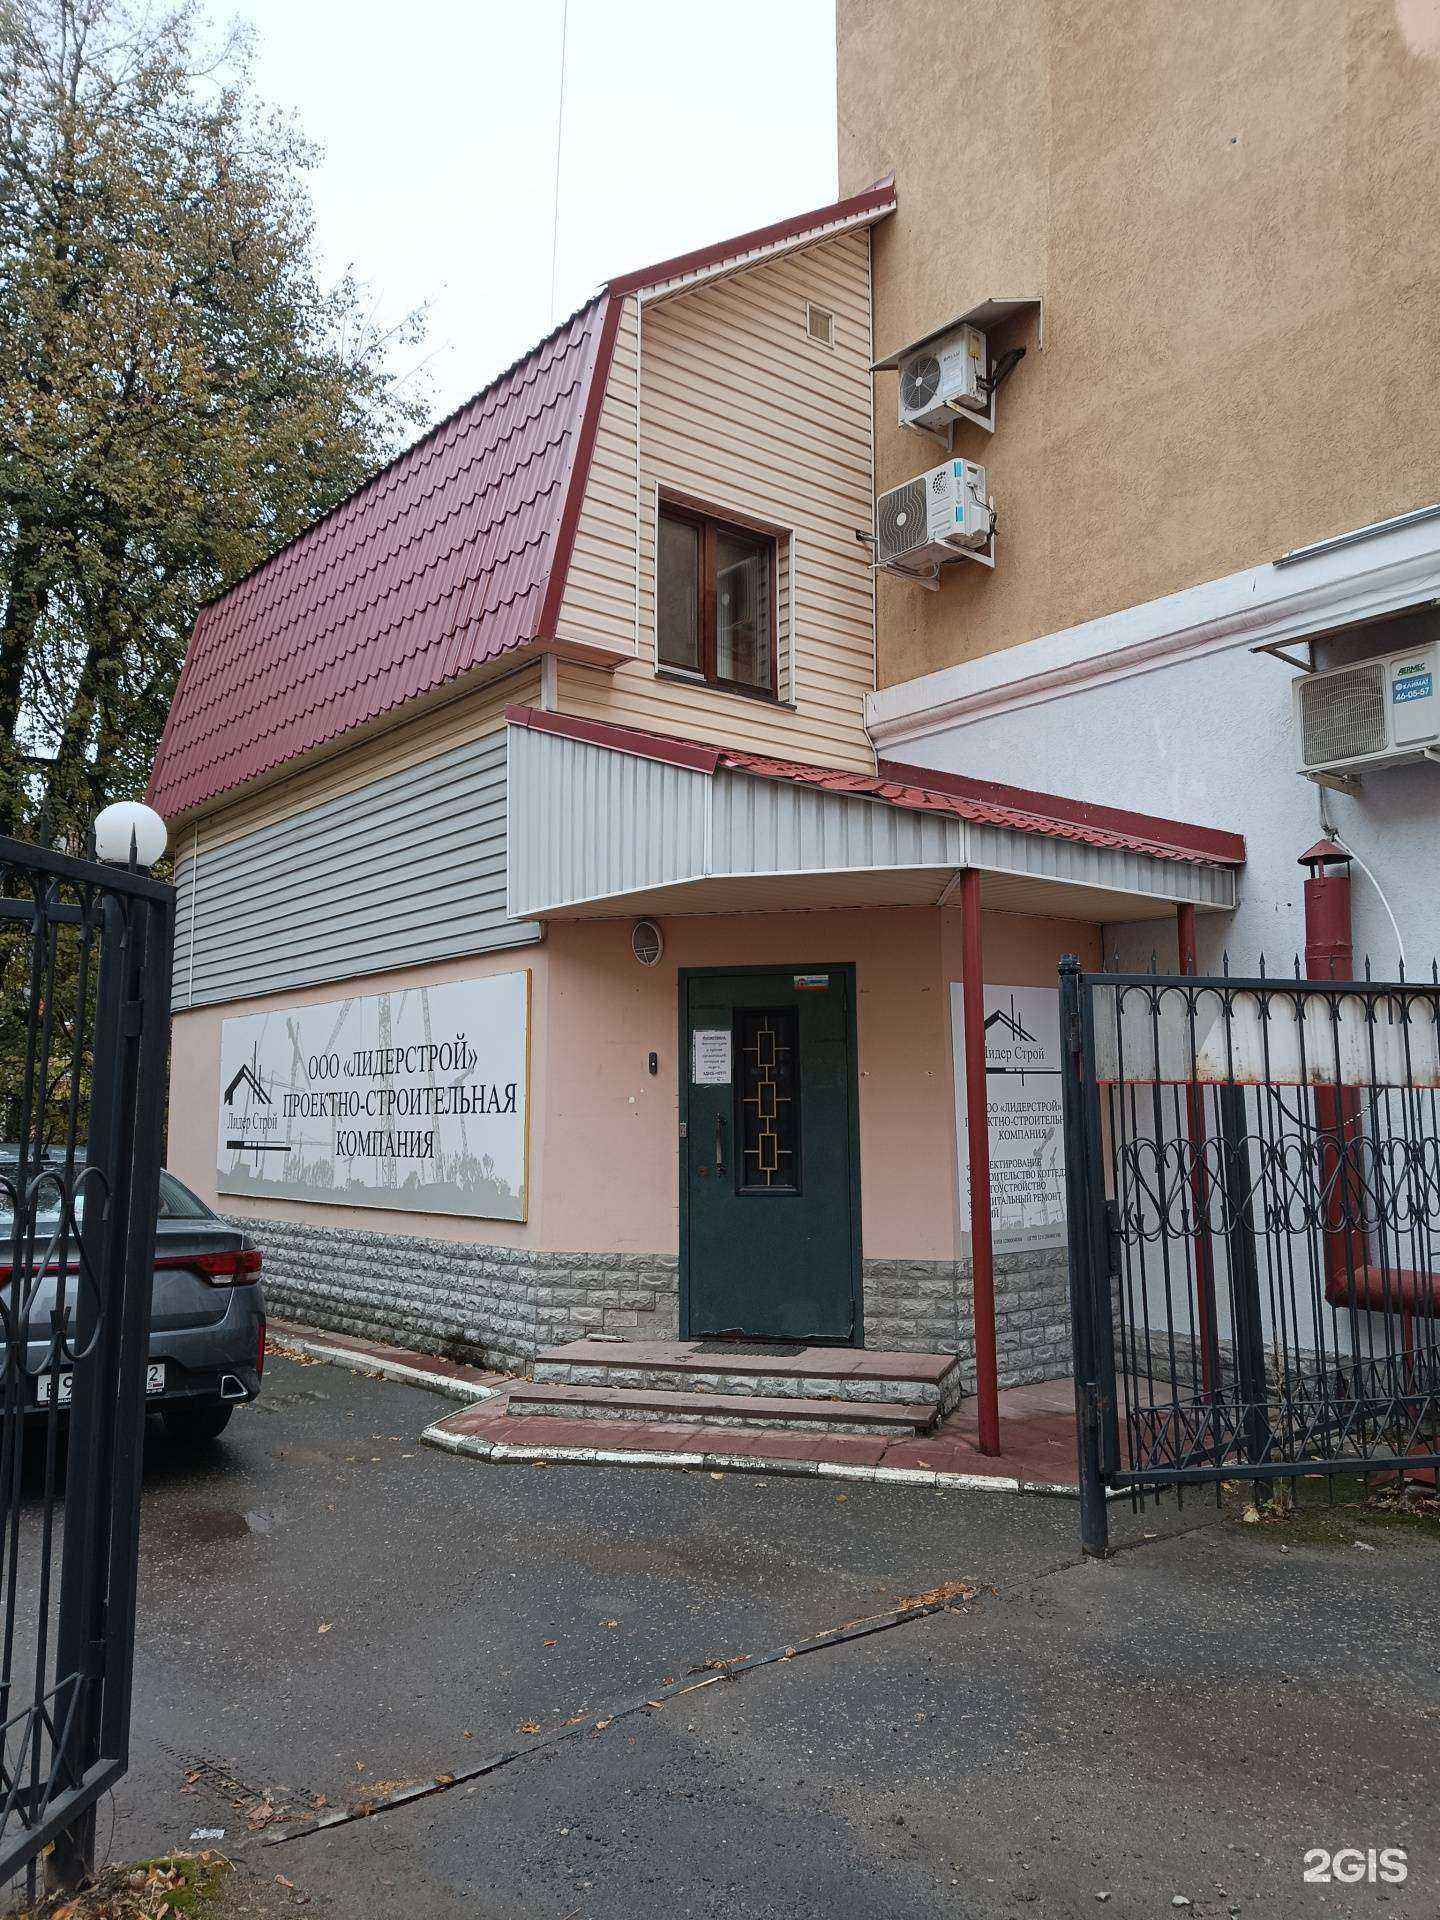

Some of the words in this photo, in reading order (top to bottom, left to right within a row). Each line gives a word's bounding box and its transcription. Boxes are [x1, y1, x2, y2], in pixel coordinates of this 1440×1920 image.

[308, 1053, 340, 1080] ООО
[343, 1032, 478, 1080] «ЛИДЕРСТРОЙ»
[1014, 1046, 1046, 1062] Строй
[283, 1083, 518, 1118] ПРОЕКТНО-СТРОИТЕЛЬНАЯ
[1000, 1099, 1062, 1113] «ЛИДЕРСТРОЙ»
[226, 1112, 251, 1134] Лидер
[252, 1110, 278, 1131] Строй
[335, 1130, 435, 1158] КОМПАНИЯ
[998, 1129, 1046, 1141] КОМПАНИЯ
[1034, 1192, 1062, 1204] РЕМОНТ
